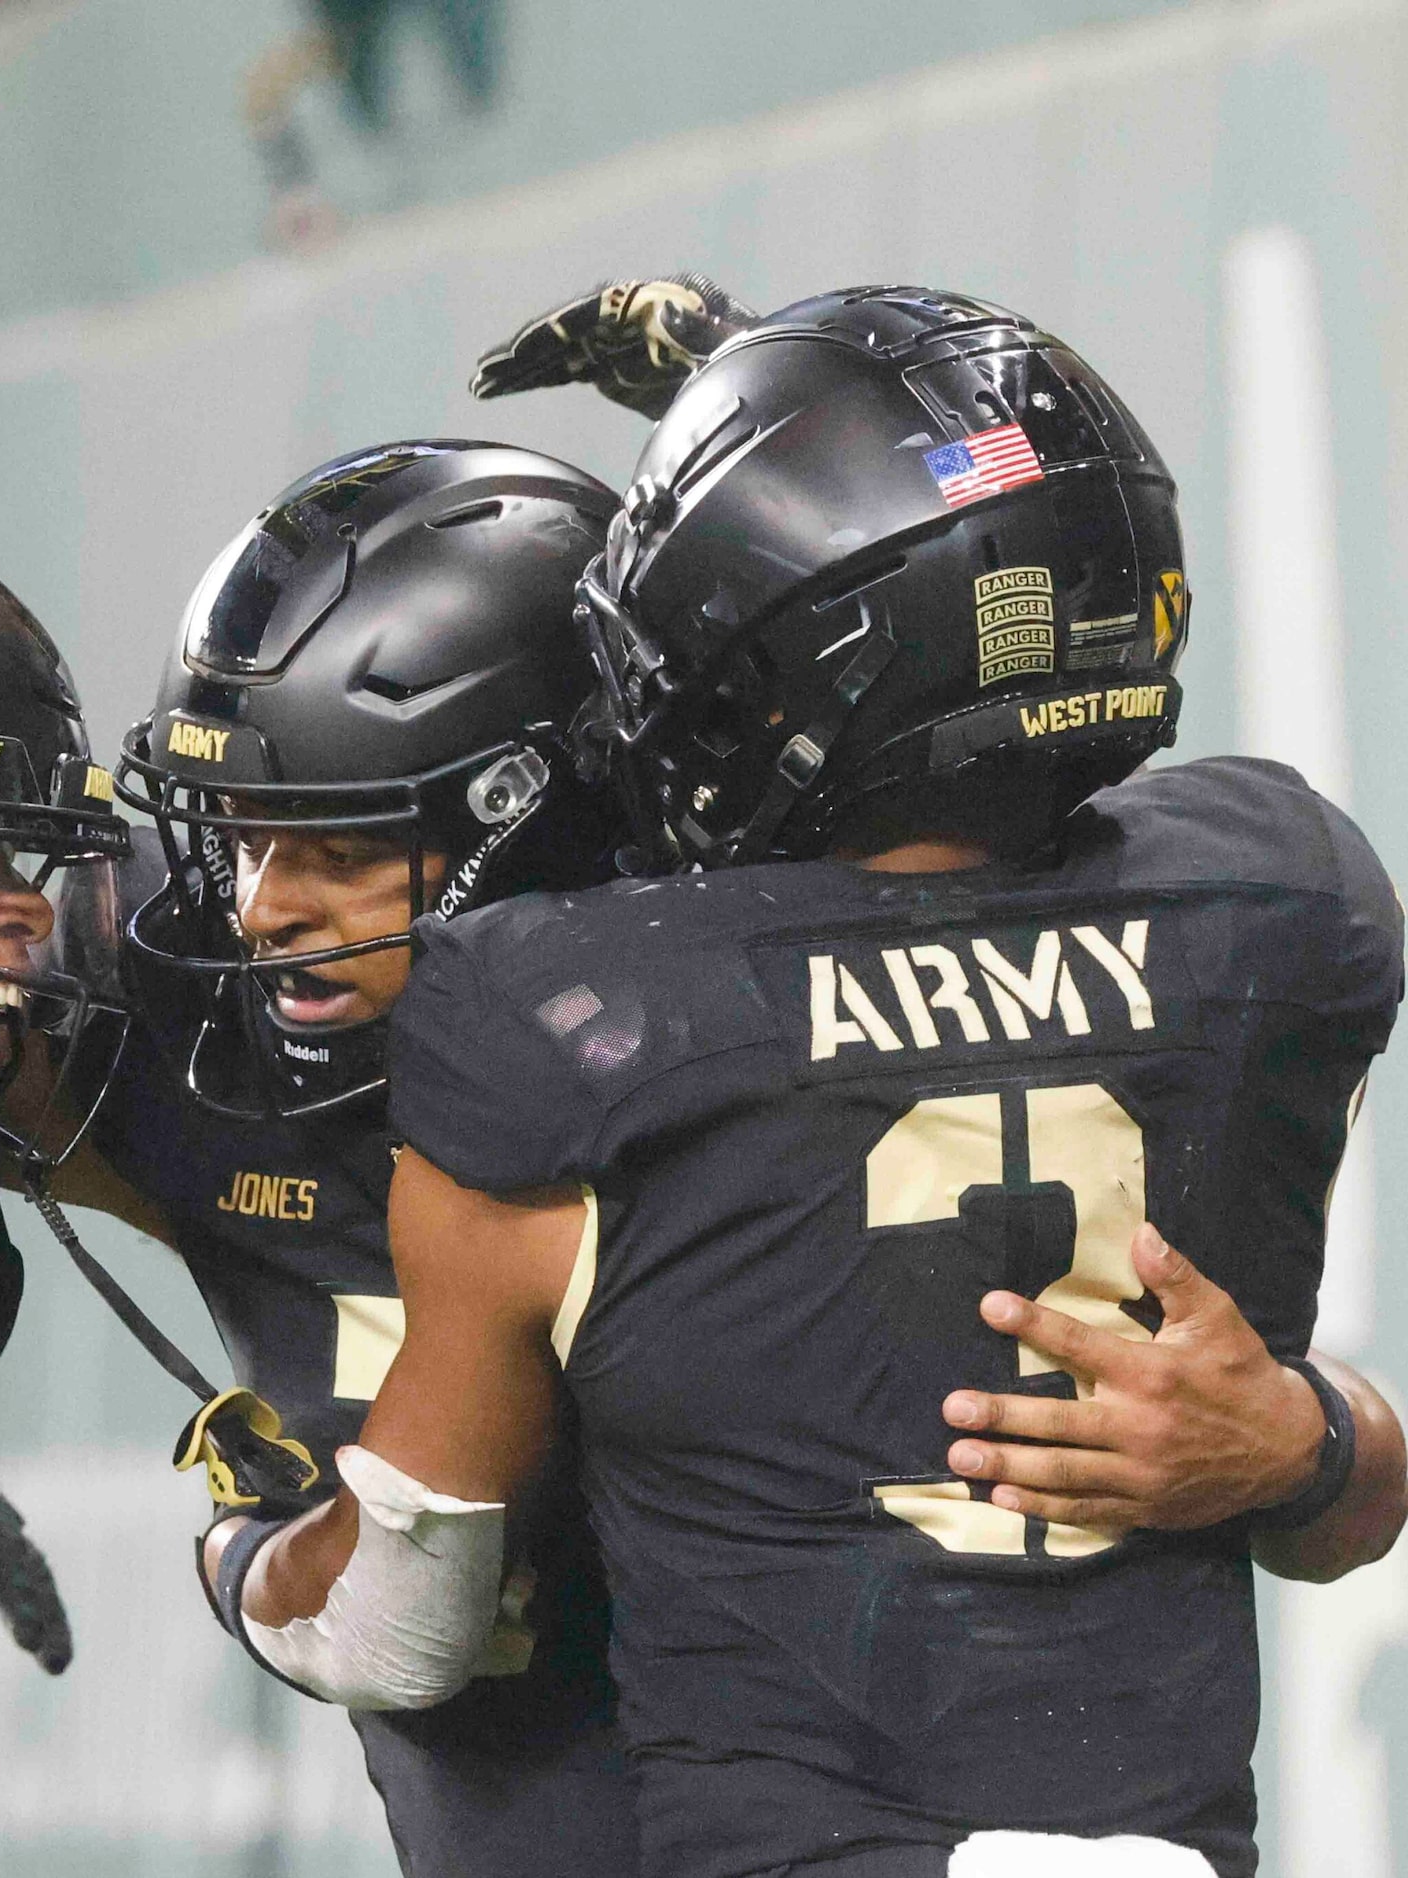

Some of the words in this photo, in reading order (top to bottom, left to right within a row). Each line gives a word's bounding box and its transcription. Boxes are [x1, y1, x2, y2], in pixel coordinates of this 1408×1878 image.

[981, 573, 1045, 596] RANGER
[983, 601, 1047, 625] RANGER
[985, 630, 1048, 653] RANGER
[985, 656, 1047, 679] RANGER
[1019, 692, 1102, 738] WEST
[1105, 684, 1168, 722] POINT
[167, 721, 231, 763] ARMY
[808, 918, 1155, 1062] ARMY
[283, 1039, 330, 1064] Riddell
[217, 1170, 319, 1221] JONES
